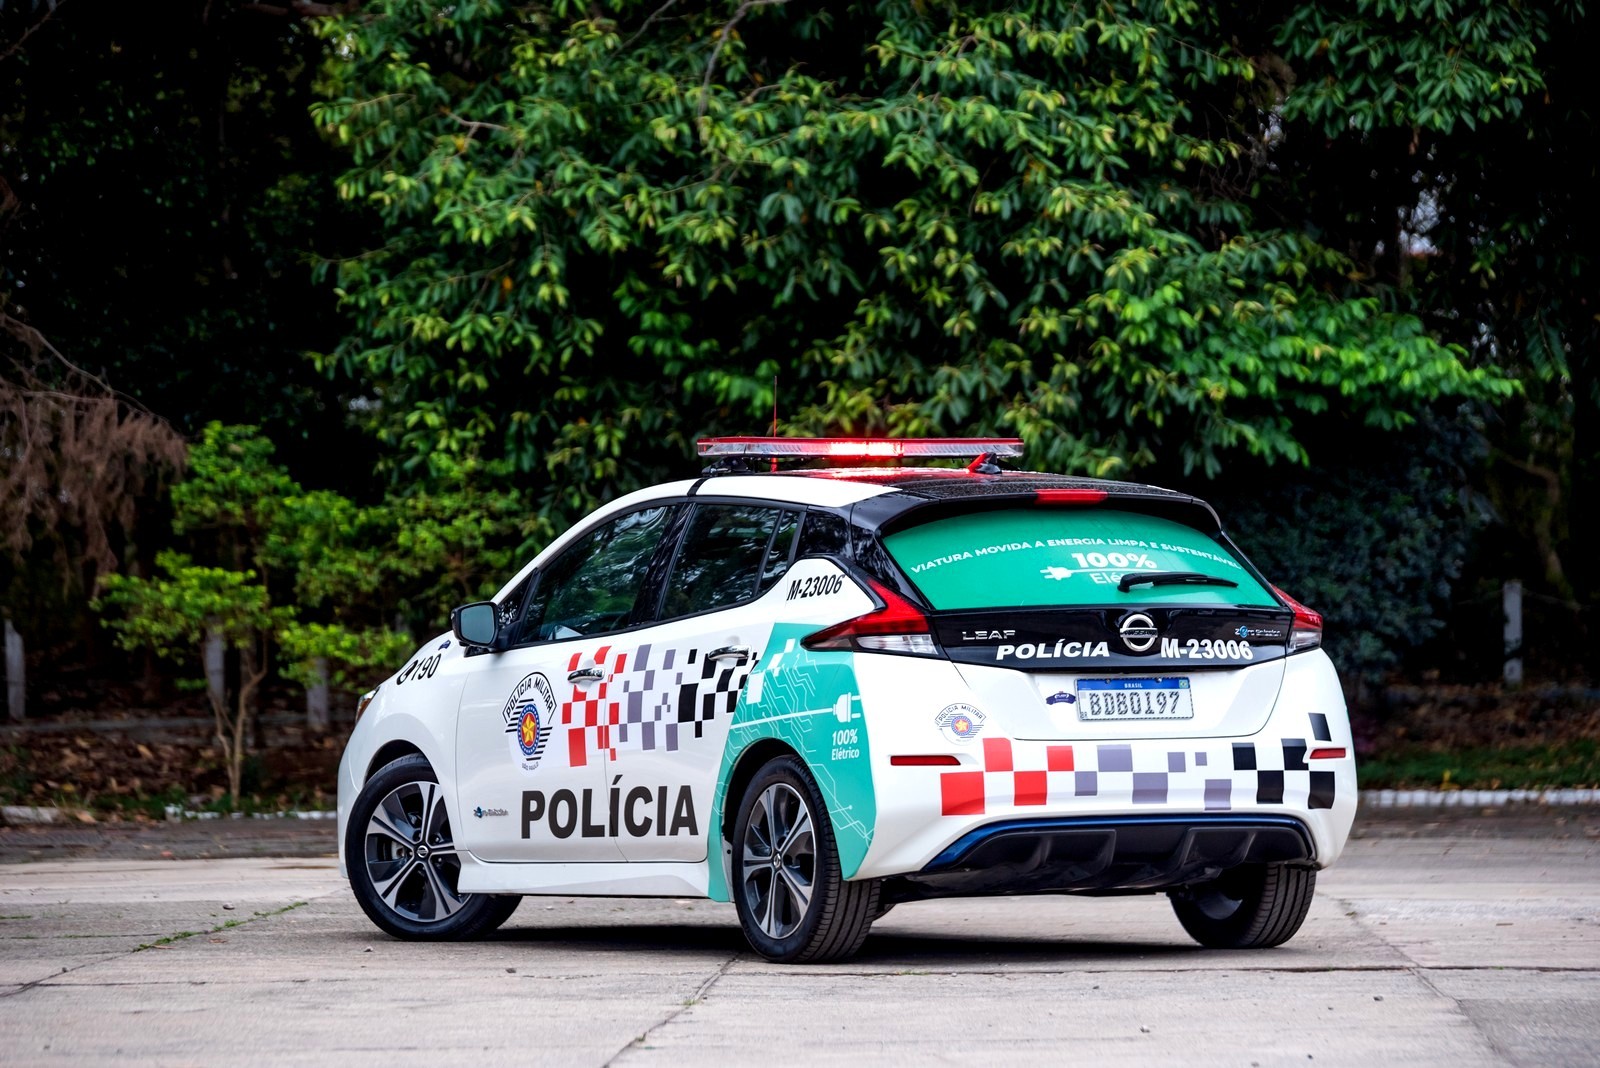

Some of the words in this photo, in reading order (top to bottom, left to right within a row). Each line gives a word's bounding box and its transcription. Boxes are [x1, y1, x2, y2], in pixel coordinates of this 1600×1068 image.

[911, 551, 973, 573] VIATURA
[974, 541, 1032, 557] MOVIDA
[1034, 540, 1046, 548] A
[1046, 538, 1106, 547] ENERGIA
[1107, 538, 1149, 548] LIMPA
[1149, 541, 1160, 549] E
[1070, 552, 1158, 569] 100%
[786, 574, 846, 601] M-23006
[961, 629, 1016, 641] LEAF
[995, 638, 1110, 661] POLÍCIA
[1160, 637, 1254, 660] M-23006
[410, 653, 442, 681] 190
[533, 677, 554, 713] MILITAR
[961, 705, 983, 719] MILITAR
[831, 728, 858, 746] 100%
[831, 746, 860, 760] Elétrico
[521, 774, 699, 839] POLÍCIA
